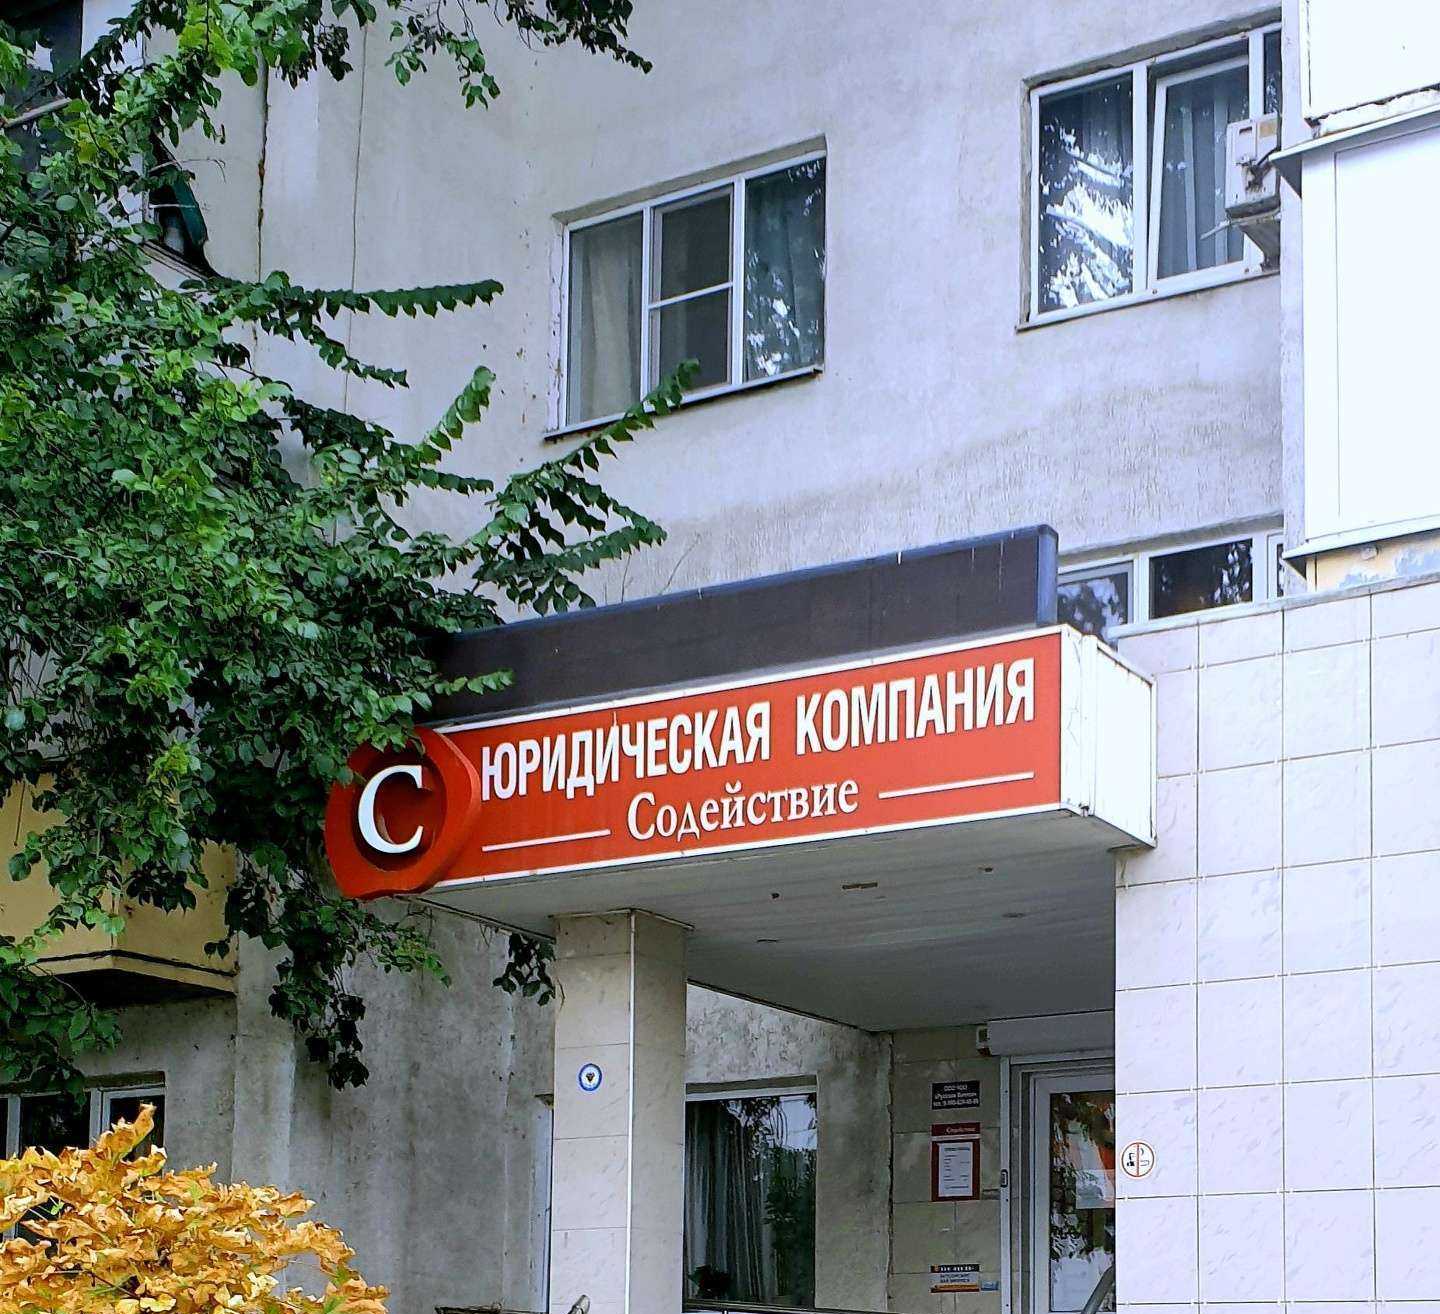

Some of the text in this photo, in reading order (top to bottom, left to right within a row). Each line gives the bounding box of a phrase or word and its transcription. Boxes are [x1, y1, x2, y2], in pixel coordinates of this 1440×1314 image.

[482, 657, 1035, 801] ЮРИДИЧЕСКАЯ КОМПАНИЯ
[627, 779, 859, 842] Содействие
